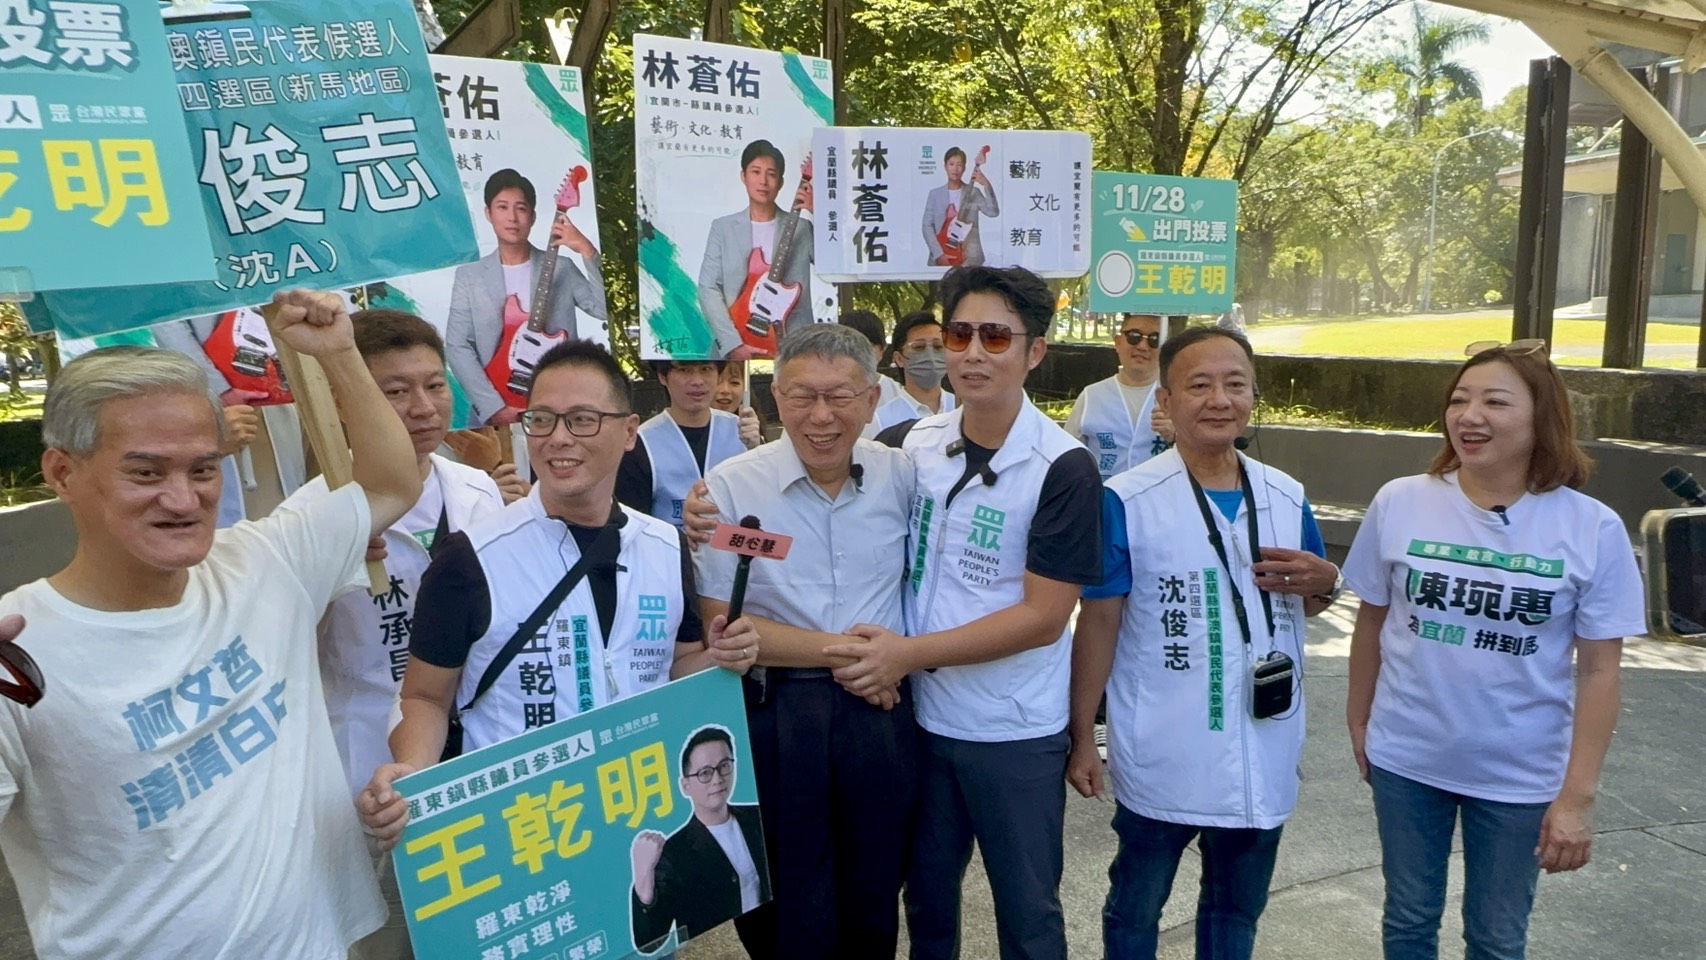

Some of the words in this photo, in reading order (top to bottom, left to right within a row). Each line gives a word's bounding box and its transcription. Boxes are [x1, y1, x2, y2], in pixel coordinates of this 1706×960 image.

[642, 49, 761, 99] 林蒼佑
[0, 138, 170, 231] 明
[200, 112, 439, 236] 俊志
[1009, 160, 1041, 179] 藝術
[851, 140, 889, 264] 林蒼佑
[1029, 193, 1060, 212] 文化
[1113, 184, 1185, 212] 11/28
[1010, 228, 1042, 246] 教育
[1152, 218, 1227, 242] 出門投票
[1136, 264, 1227, 295] 王乾明
[958, 559, 1000, 577] PEOPLE'S
[963, 548, 1000, 565] TAIWAN
[962, 571, 993, 586] PARTY
[1158, 575, 1191, 671] 沈俊志
[556, 619, 571, 667] 羅東鎮
[121, 634, 264, 751] 柯文哲
[405, 741, 674, 922] 王乾明
[476, 880, 571, 939] 羅東乾淨
